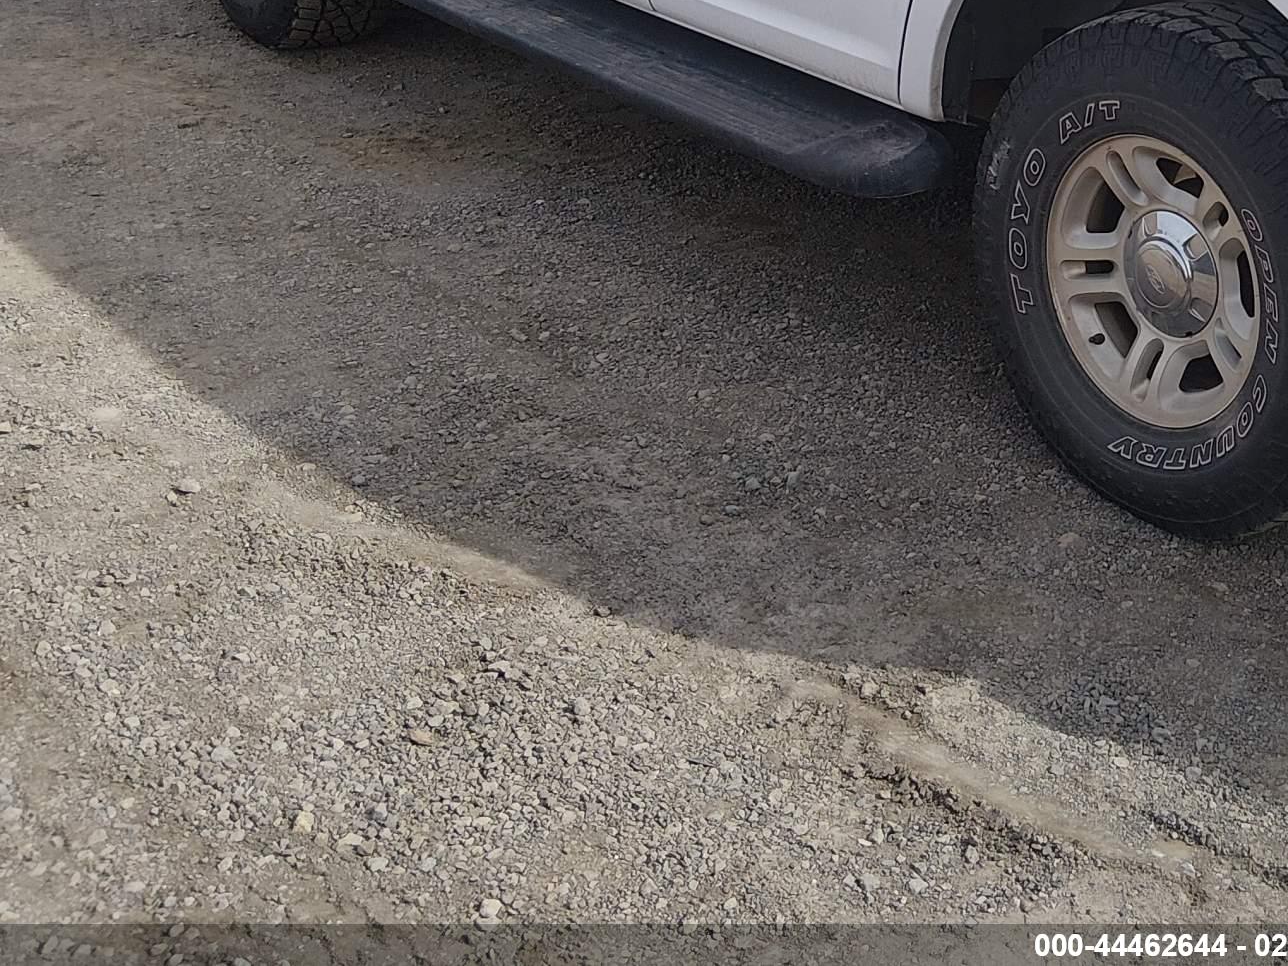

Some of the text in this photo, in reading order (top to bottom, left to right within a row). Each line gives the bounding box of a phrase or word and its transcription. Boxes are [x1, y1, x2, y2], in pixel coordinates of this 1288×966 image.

[1008, 99, 1121, 315] TOYO A/T
[1107, 207, 1280, 471] OPEN COUNTRY
